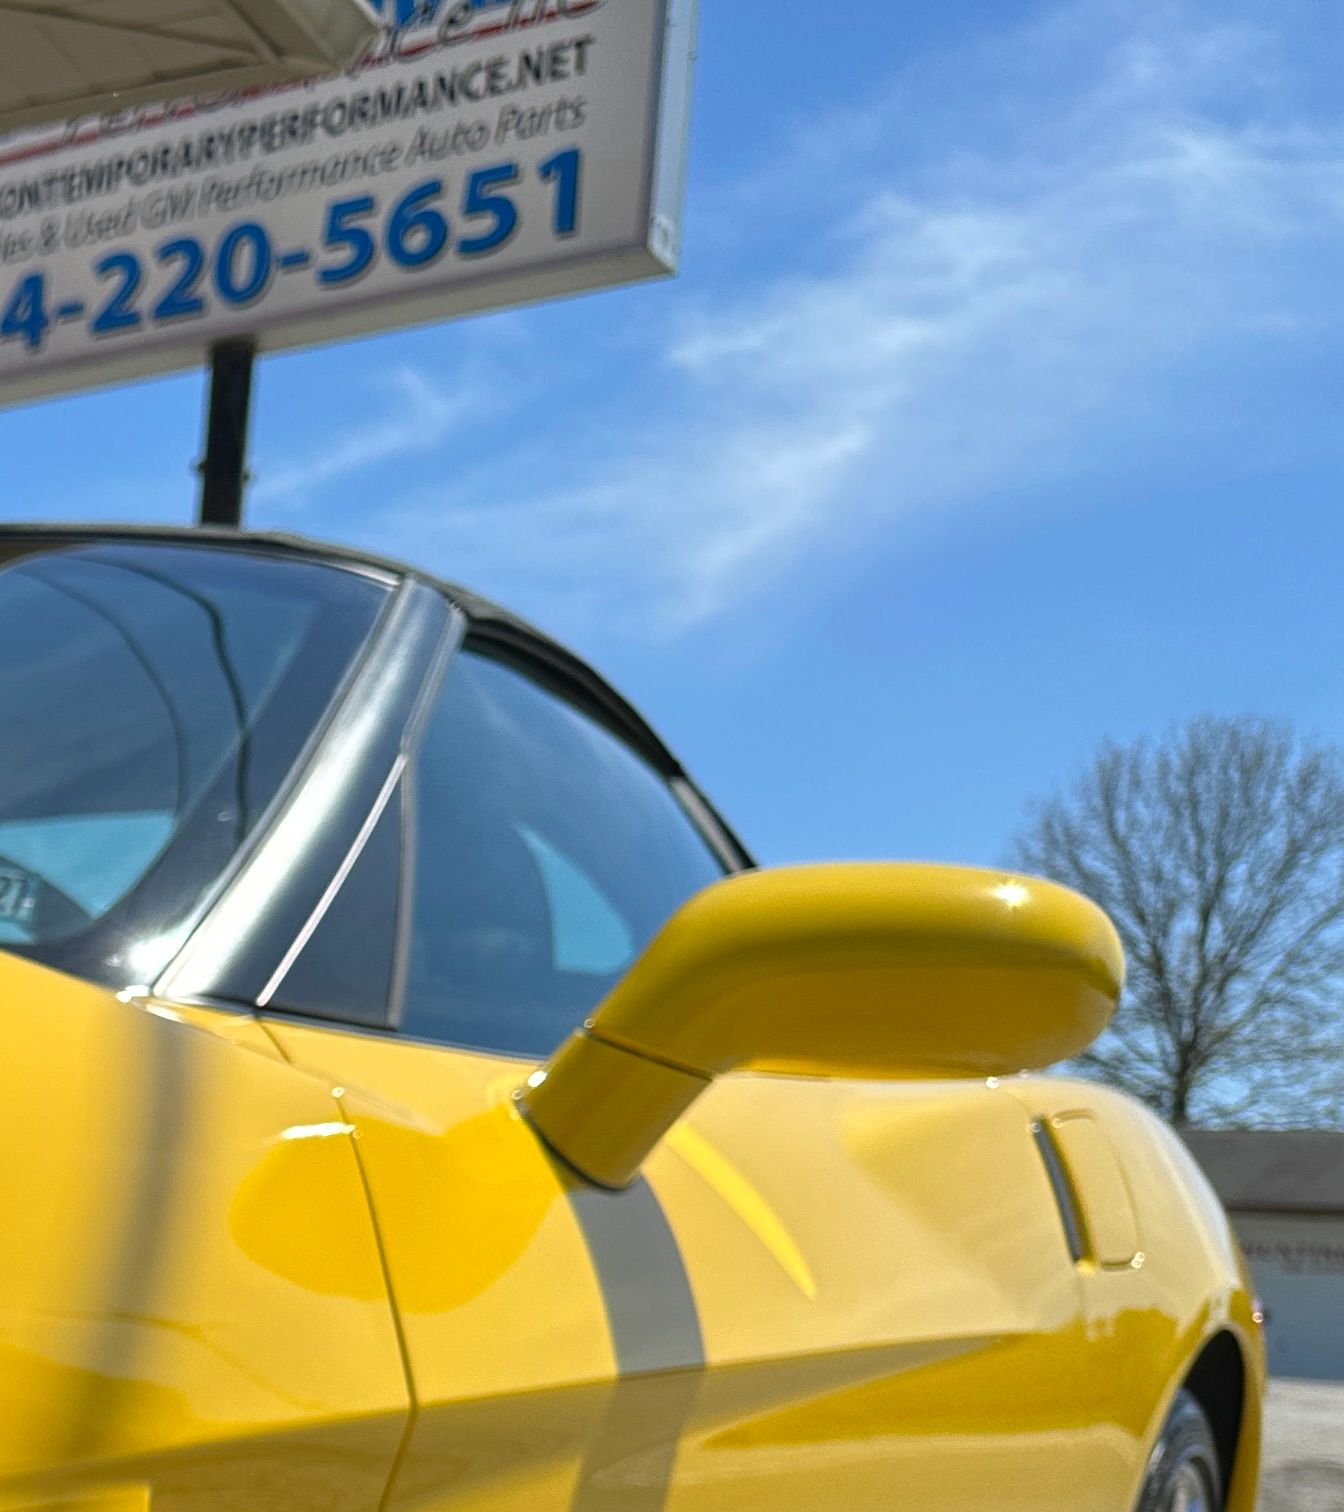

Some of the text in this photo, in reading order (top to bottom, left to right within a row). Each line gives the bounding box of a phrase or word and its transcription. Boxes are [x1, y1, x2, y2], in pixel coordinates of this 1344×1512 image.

[64, 192, 138, 249] Used
[139, 176, 195, 231] GM
[196, 138, 406, 216] Performance
[406, 118, 490, 166] Auto
[494, 95, 588, 148] Parts
